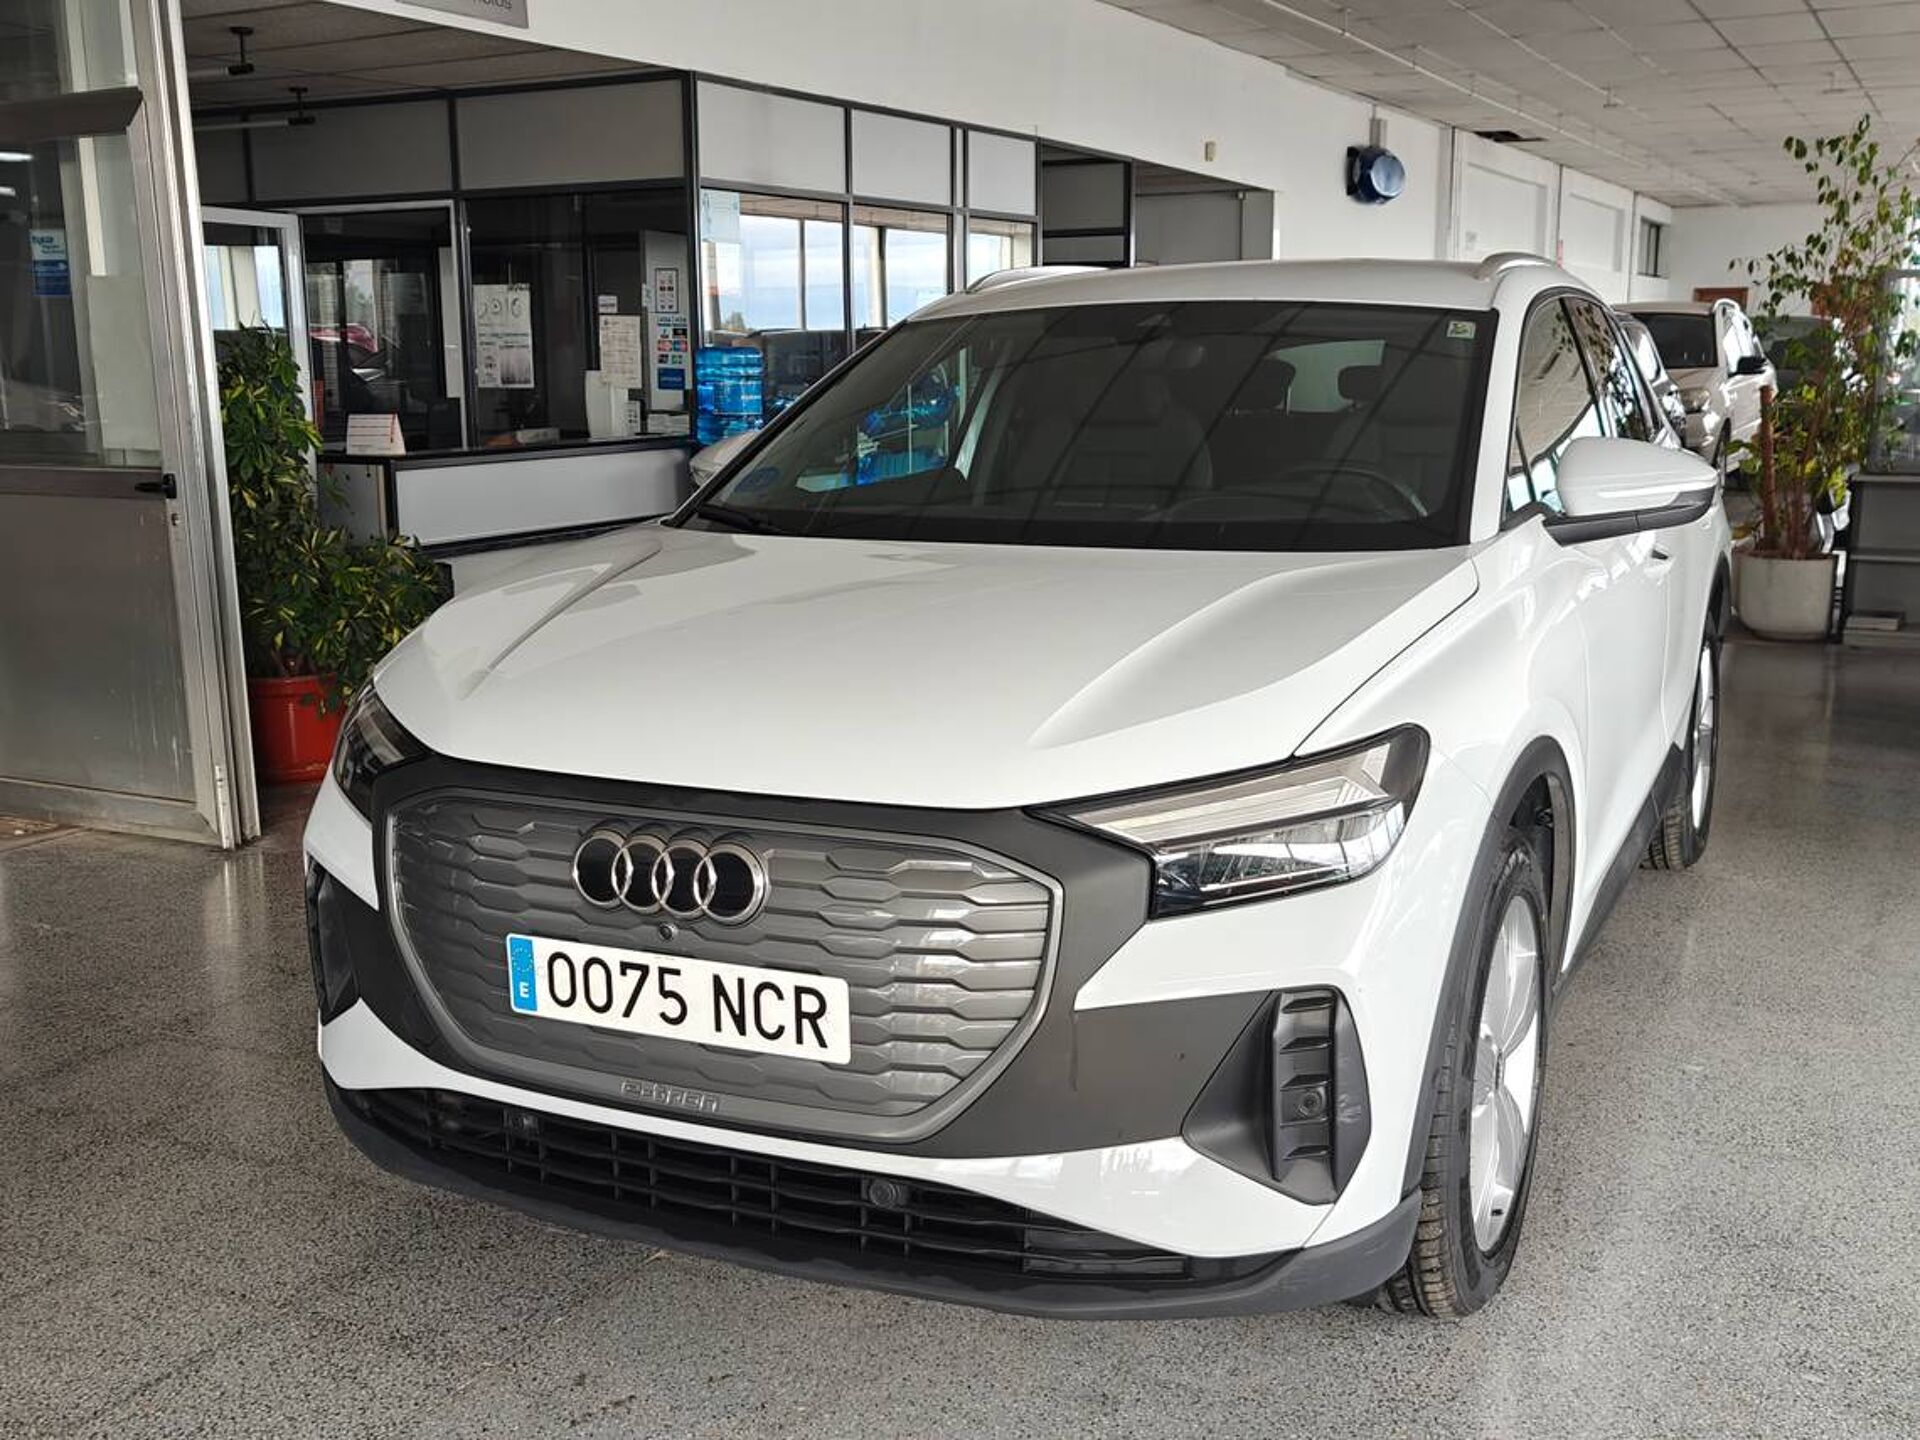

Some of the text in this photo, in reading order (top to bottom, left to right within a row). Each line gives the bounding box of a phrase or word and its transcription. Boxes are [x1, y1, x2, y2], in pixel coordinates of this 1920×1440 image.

[519, 951, 828, 1048] E 0075 NCR
